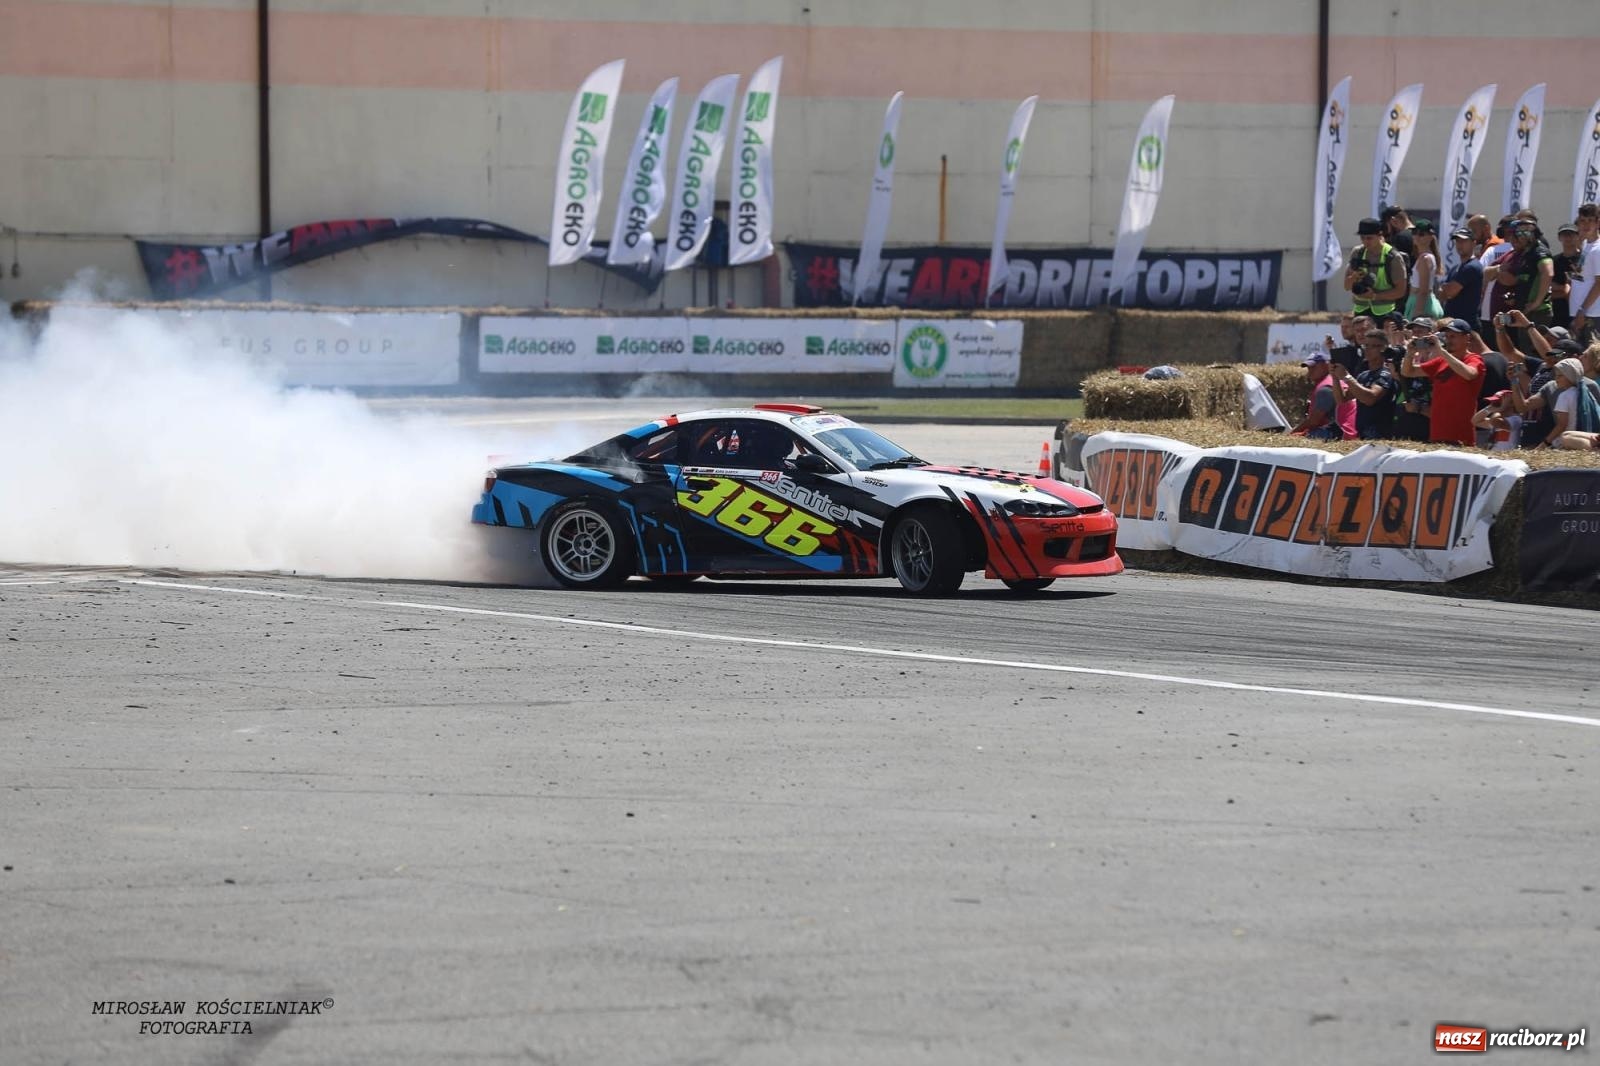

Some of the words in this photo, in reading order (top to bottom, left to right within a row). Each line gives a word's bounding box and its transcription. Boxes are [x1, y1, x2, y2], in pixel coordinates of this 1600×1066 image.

[563, 127, 597, 246] AGROEKO
[676, 135, 712, 252] AGROEKO
[739, 127, 763, 245] AGROEKO
[294, 338, 393, 354] GROUP
[506, 336, 576, 355] AGROEKO
[613, 337, 685, 355] AGROEKO
[711, 337, 785, 356] AGROEKO
[826, 338, 891, 356] AGROEKO
[762, 471, 777, 481] 366
[1554, 493, 1588, 506] AUTO
[677, 475, 837, 556] 366
